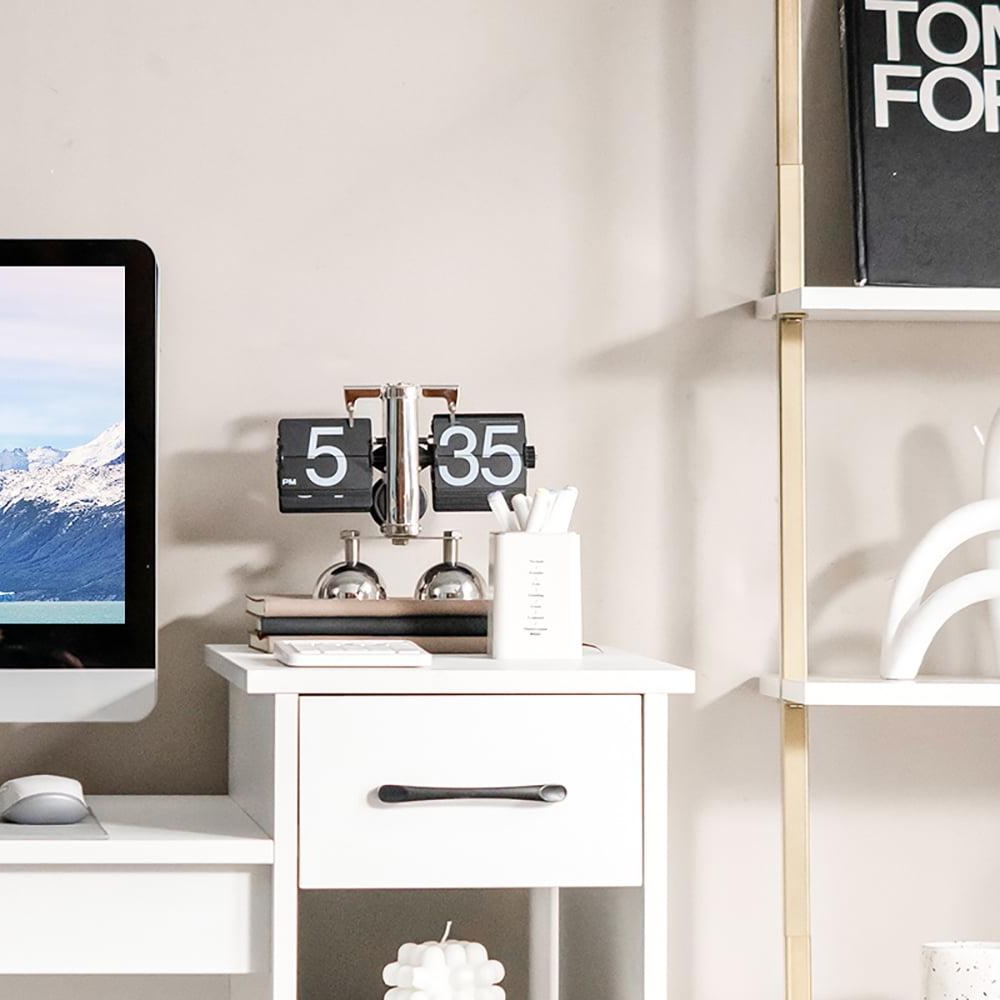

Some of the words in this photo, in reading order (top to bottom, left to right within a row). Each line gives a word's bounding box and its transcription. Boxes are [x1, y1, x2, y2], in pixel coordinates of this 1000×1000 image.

[281, 478, 297, 486] PM
[305, 426, 348, 487] 5
[438, 425, 522, 487] 35
